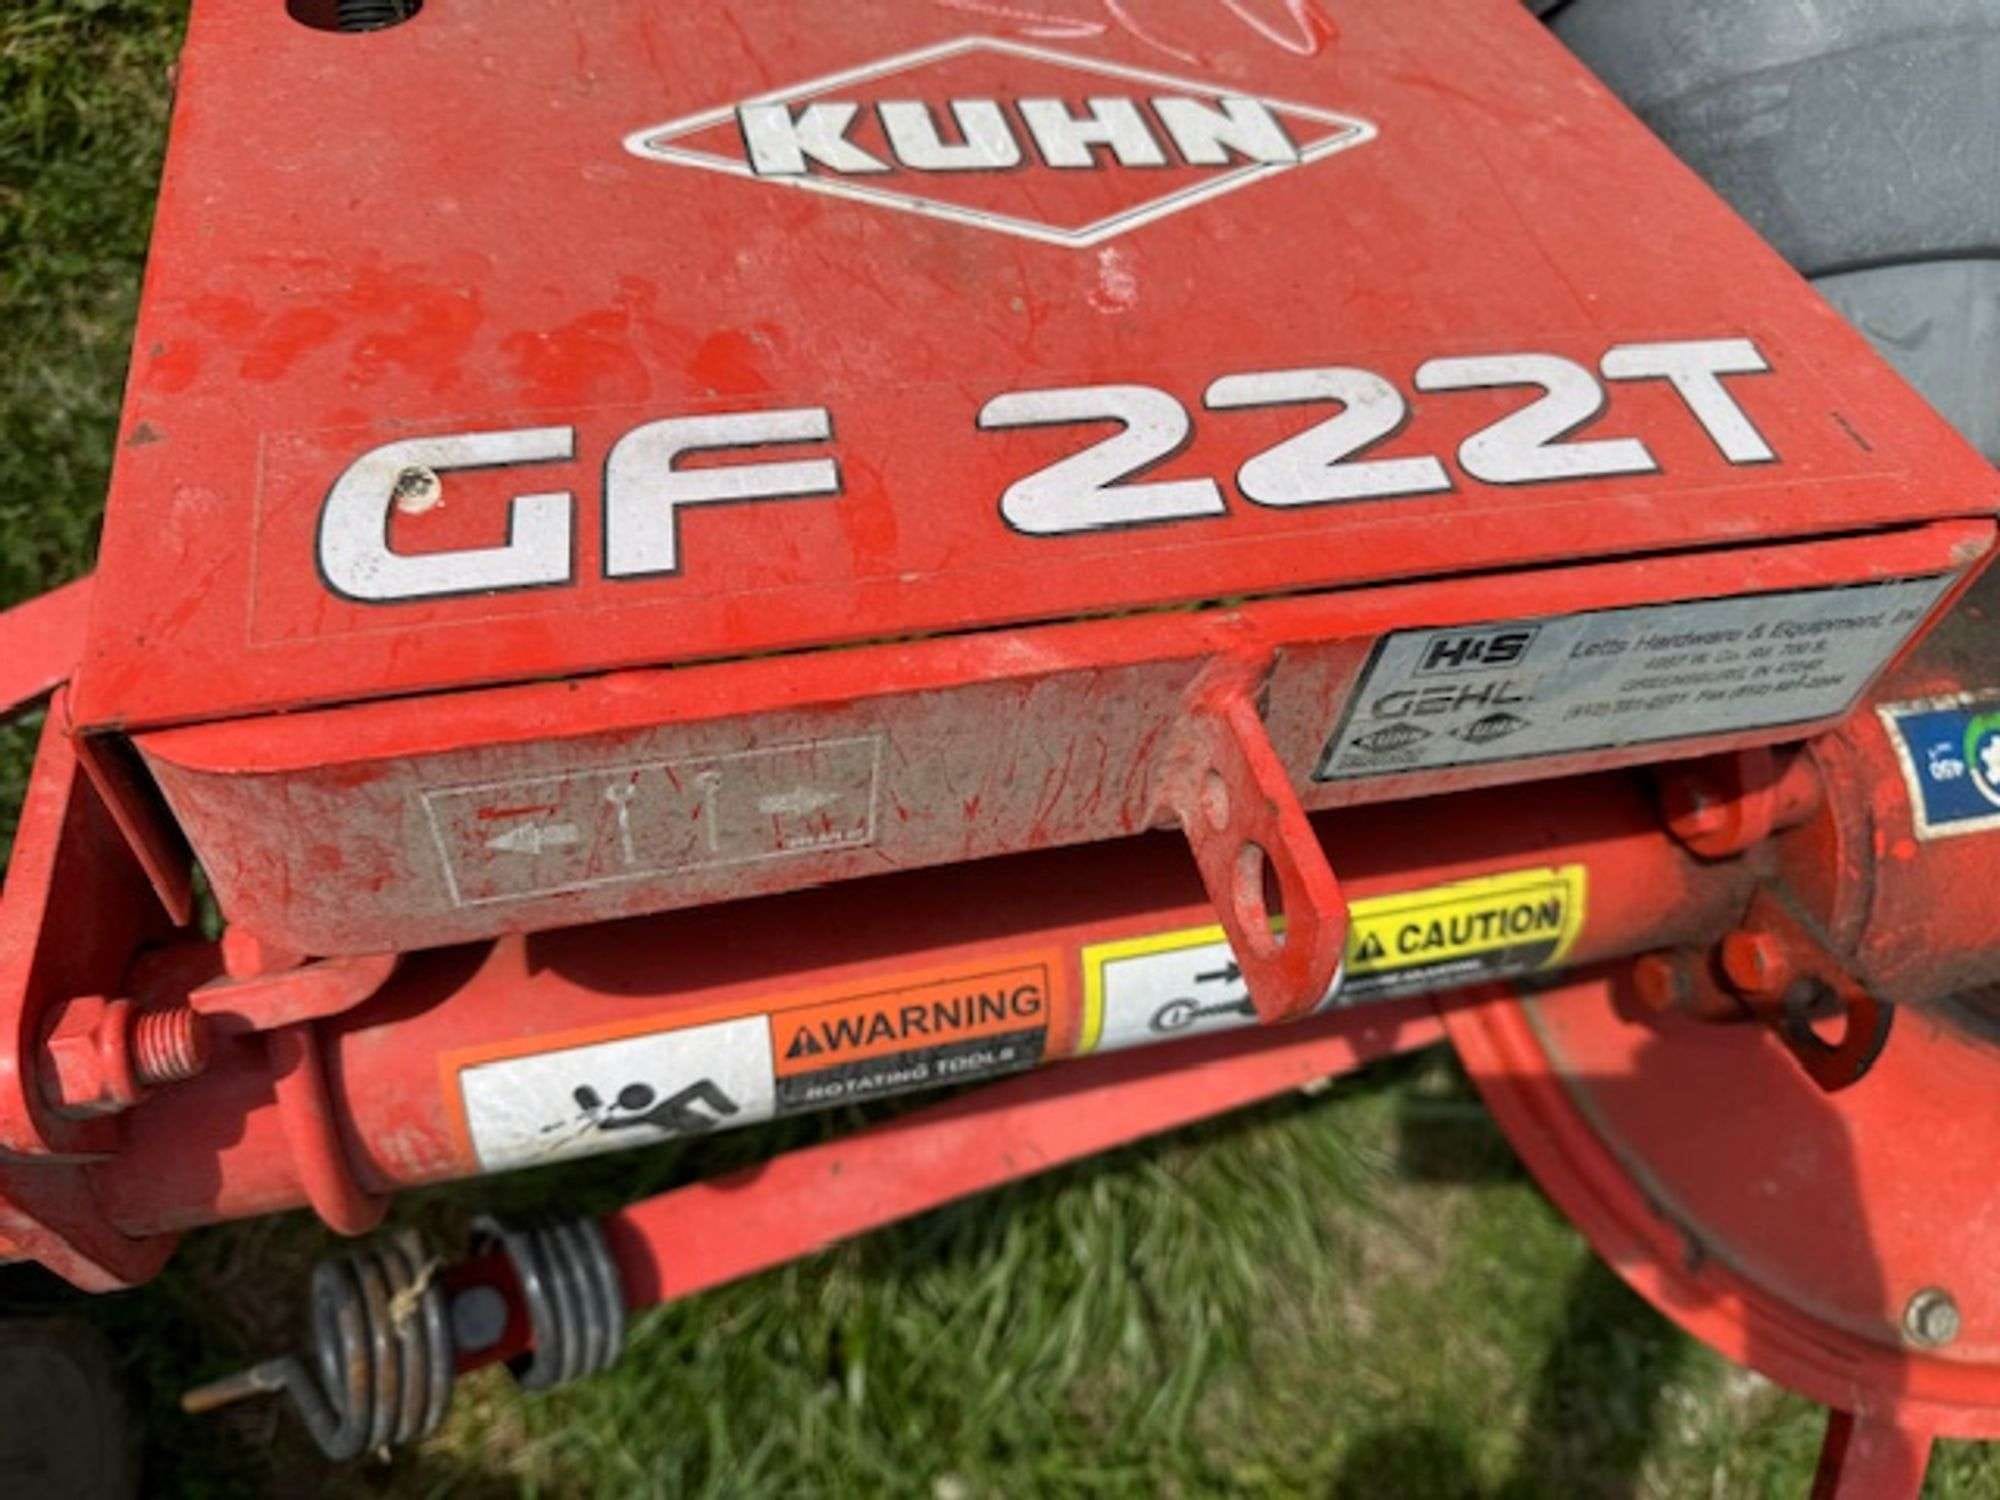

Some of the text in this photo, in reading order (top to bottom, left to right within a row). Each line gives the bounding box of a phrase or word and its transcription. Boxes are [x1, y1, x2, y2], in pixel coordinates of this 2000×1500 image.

[736, 96, 1302, 176] KUHN
[315, 337, 1780, 604] GF 222T
[1423, 633, 1531, 669] H&S
[1633, 628, 1745, 652] Hardware
[1747, 621, 1767, 641] &
[1371, 680, 1525, 719] GEHL
[1397, 896, 1562, 955] CAUTION
[821, 984, 1041, 1051] WARNING
[805, 1047, 1015, 1100] ROTATING TOOLS
